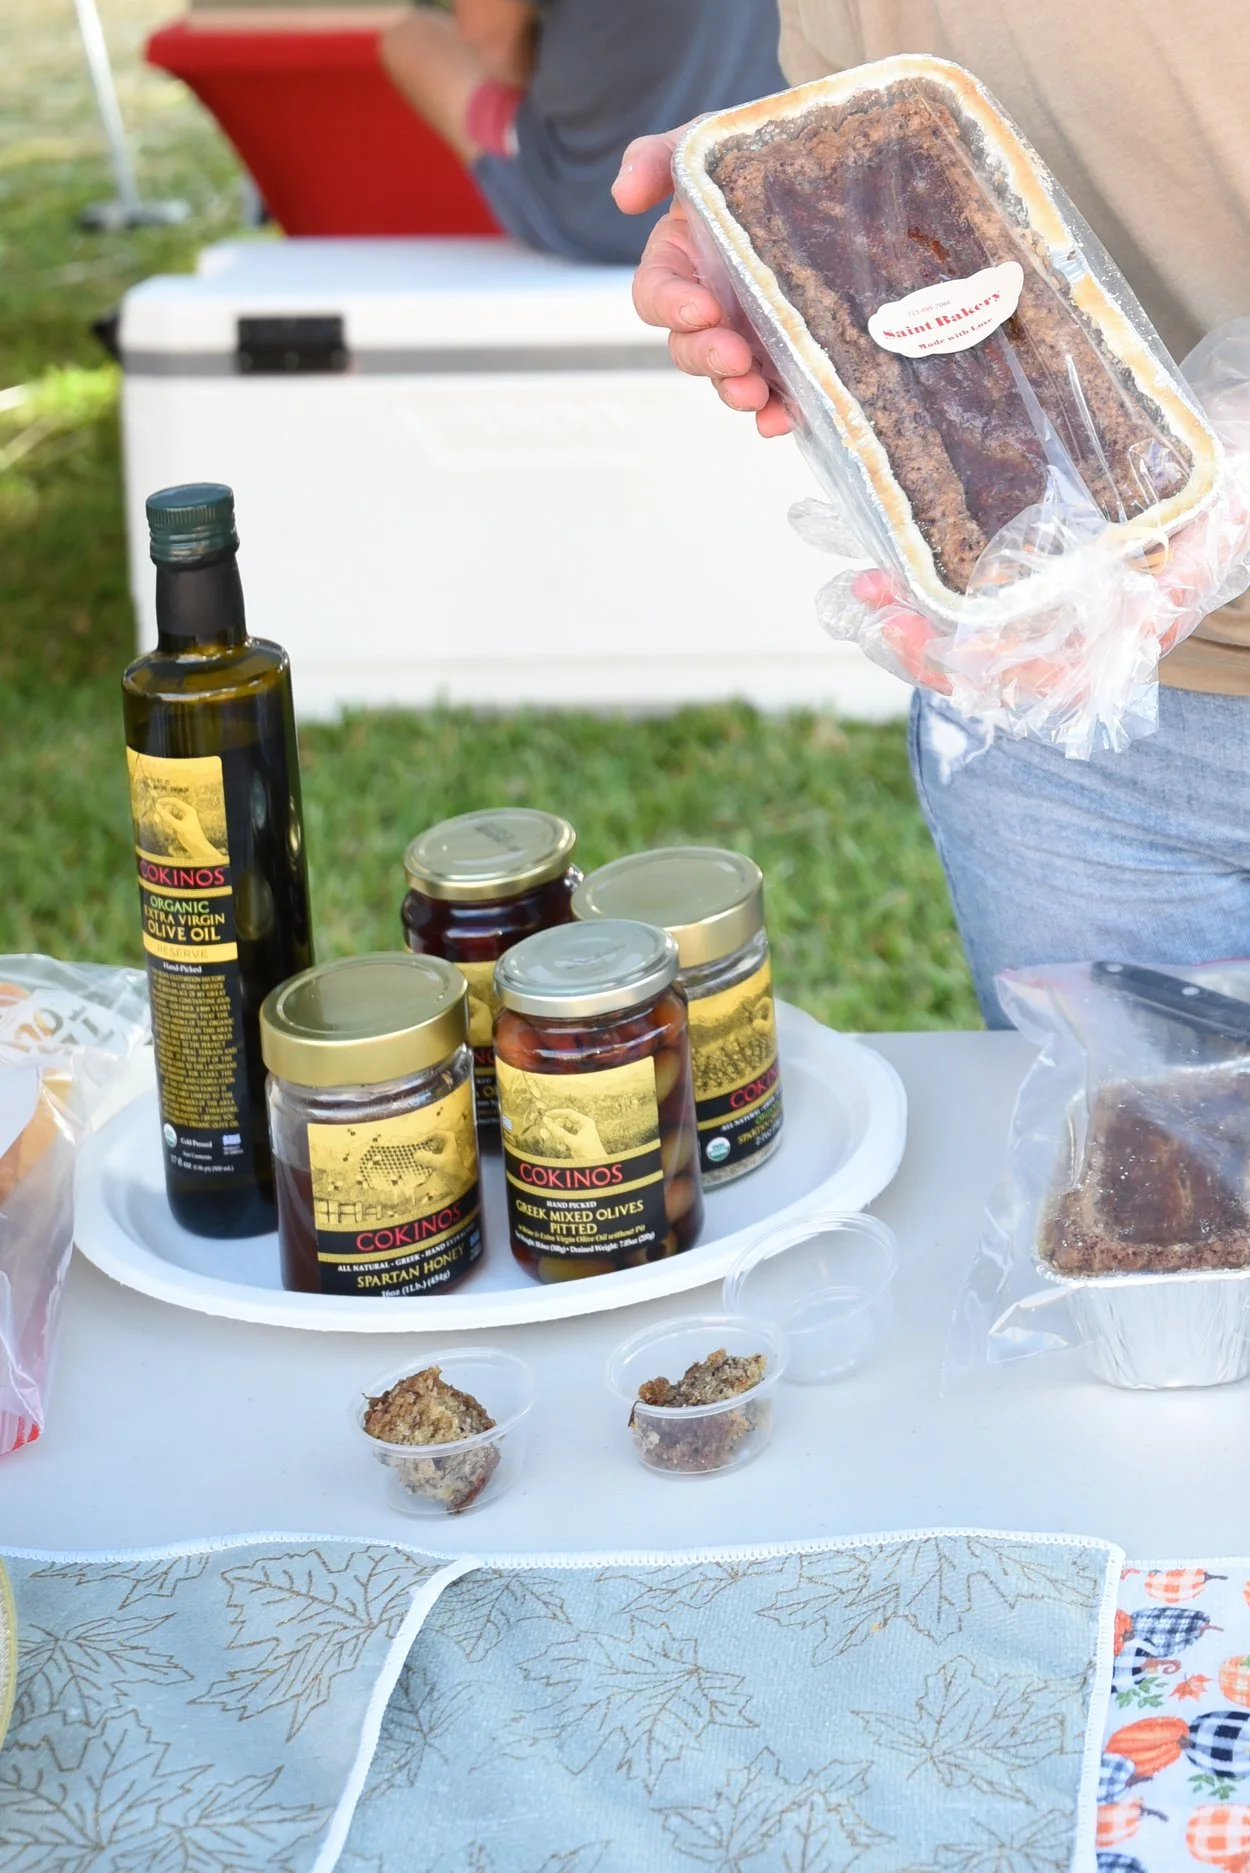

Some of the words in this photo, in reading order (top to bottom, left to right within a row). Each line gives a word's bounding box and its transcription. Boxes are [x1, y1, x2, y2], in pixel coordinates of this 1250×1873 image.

[882, 321, 932, 340] Saint
[935, 290, 1001, 328] Bakery
[918, 339, 945, 351] Made
[948, 329, 969, 342] with
[971, 318, 993, 332] Love
[140, 859, 225, 887] COKINOS
[144, 904, 175, 925] EXTRA
[178, 912, 225, 927] VIRGIN
[150, 895, 210, 914] ORGANIC
[147, 919, 187, 941] OLIVE
[190, 926, 221, 942] OIL
[157, 946, 208, 959] RESERVE
[163, 961, 202, 974] Hand-Picked
[519, 1162, 624, 1189] COKINOS
[516, 1199, 548, 1220] GREEK
[549, 1210, 593, 1223] MIXED
[595, 1199, 644, 1221] OLIVES
[546, 1200, 568, 1209] HAND
[568, 1200, 598, 1209] PICKED
[355, 1203, 462, 1252] COKINOS
[550, 1223, 598, 1236] PITTED
[337, 1264, 352, 1273] ALL
[352, 1261, 390, 1273] NATURAL
[395, 1253, 421, 1267] GREEK
[425, 1241, 446, 1258] HAND
[356, 1265, 420, 1289] SPARTAN
[423, 1241, 466, 1275] HONEY
